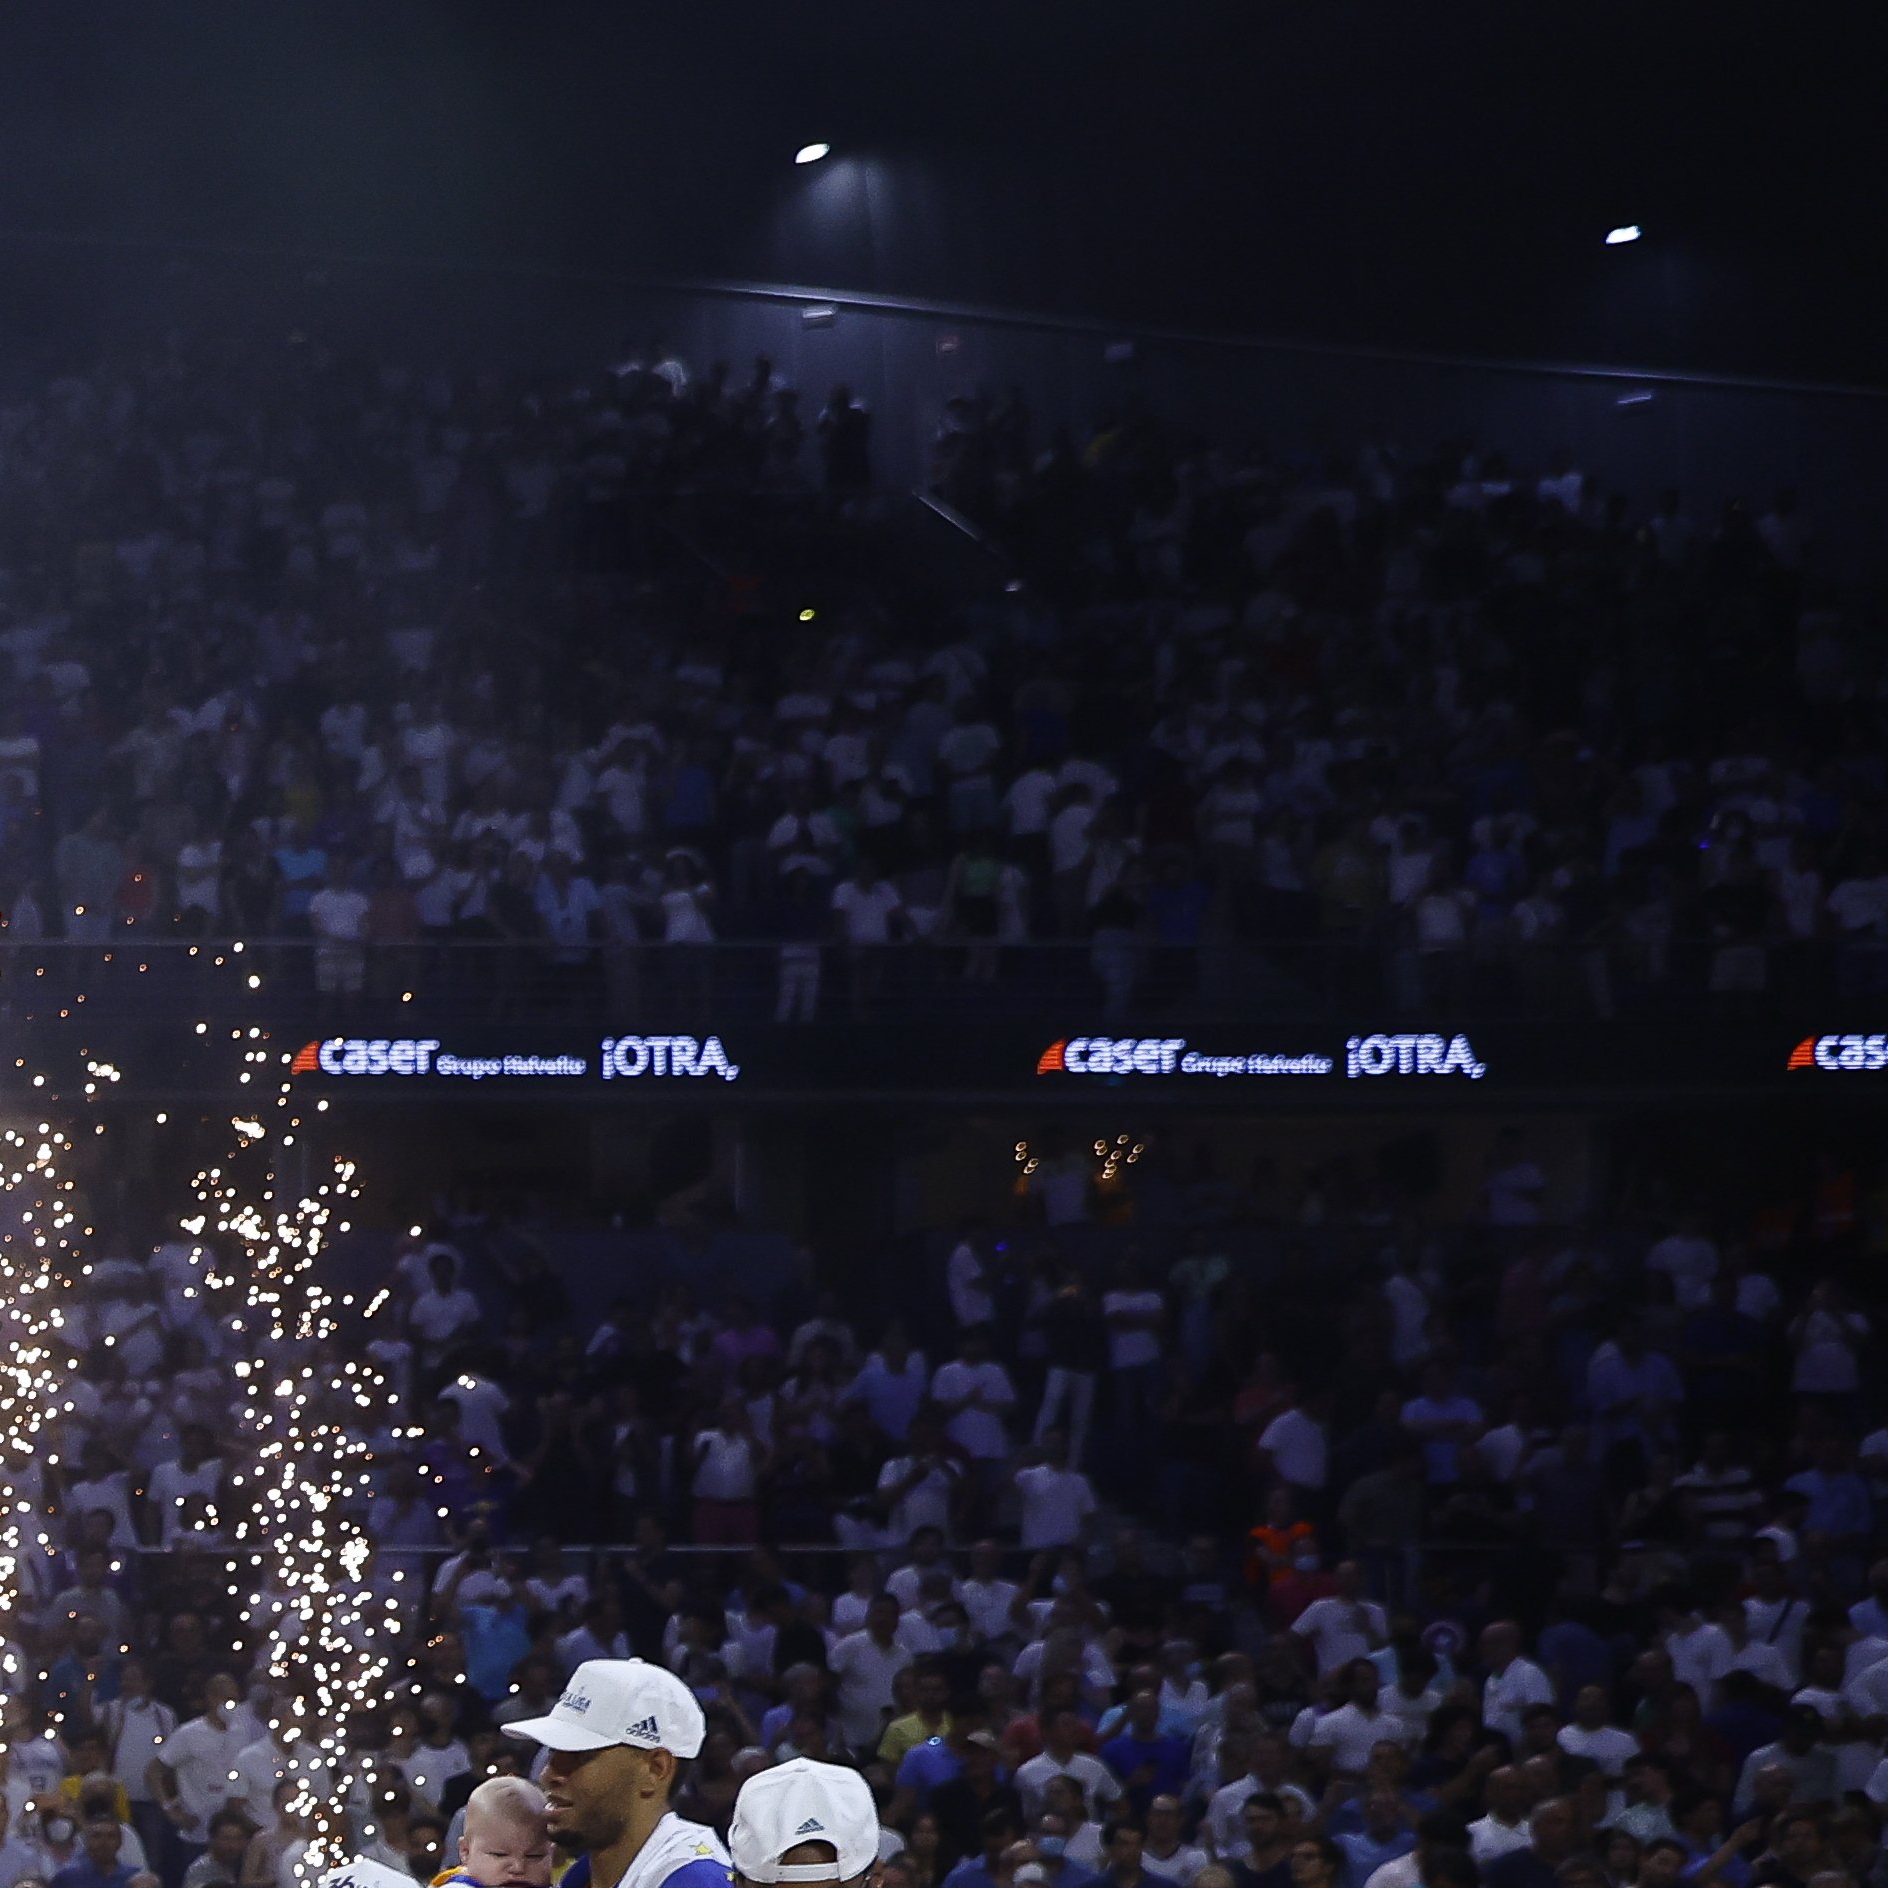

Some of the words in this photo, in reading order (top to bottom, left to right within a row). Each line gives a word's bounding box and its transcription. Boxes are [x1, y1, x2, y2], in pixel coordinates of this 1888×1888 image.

[318, 1038, 441, 1076] caser
[1062, 1036, 1186, 1076] caser
[1815, 1034, 1888, 1070] cas
